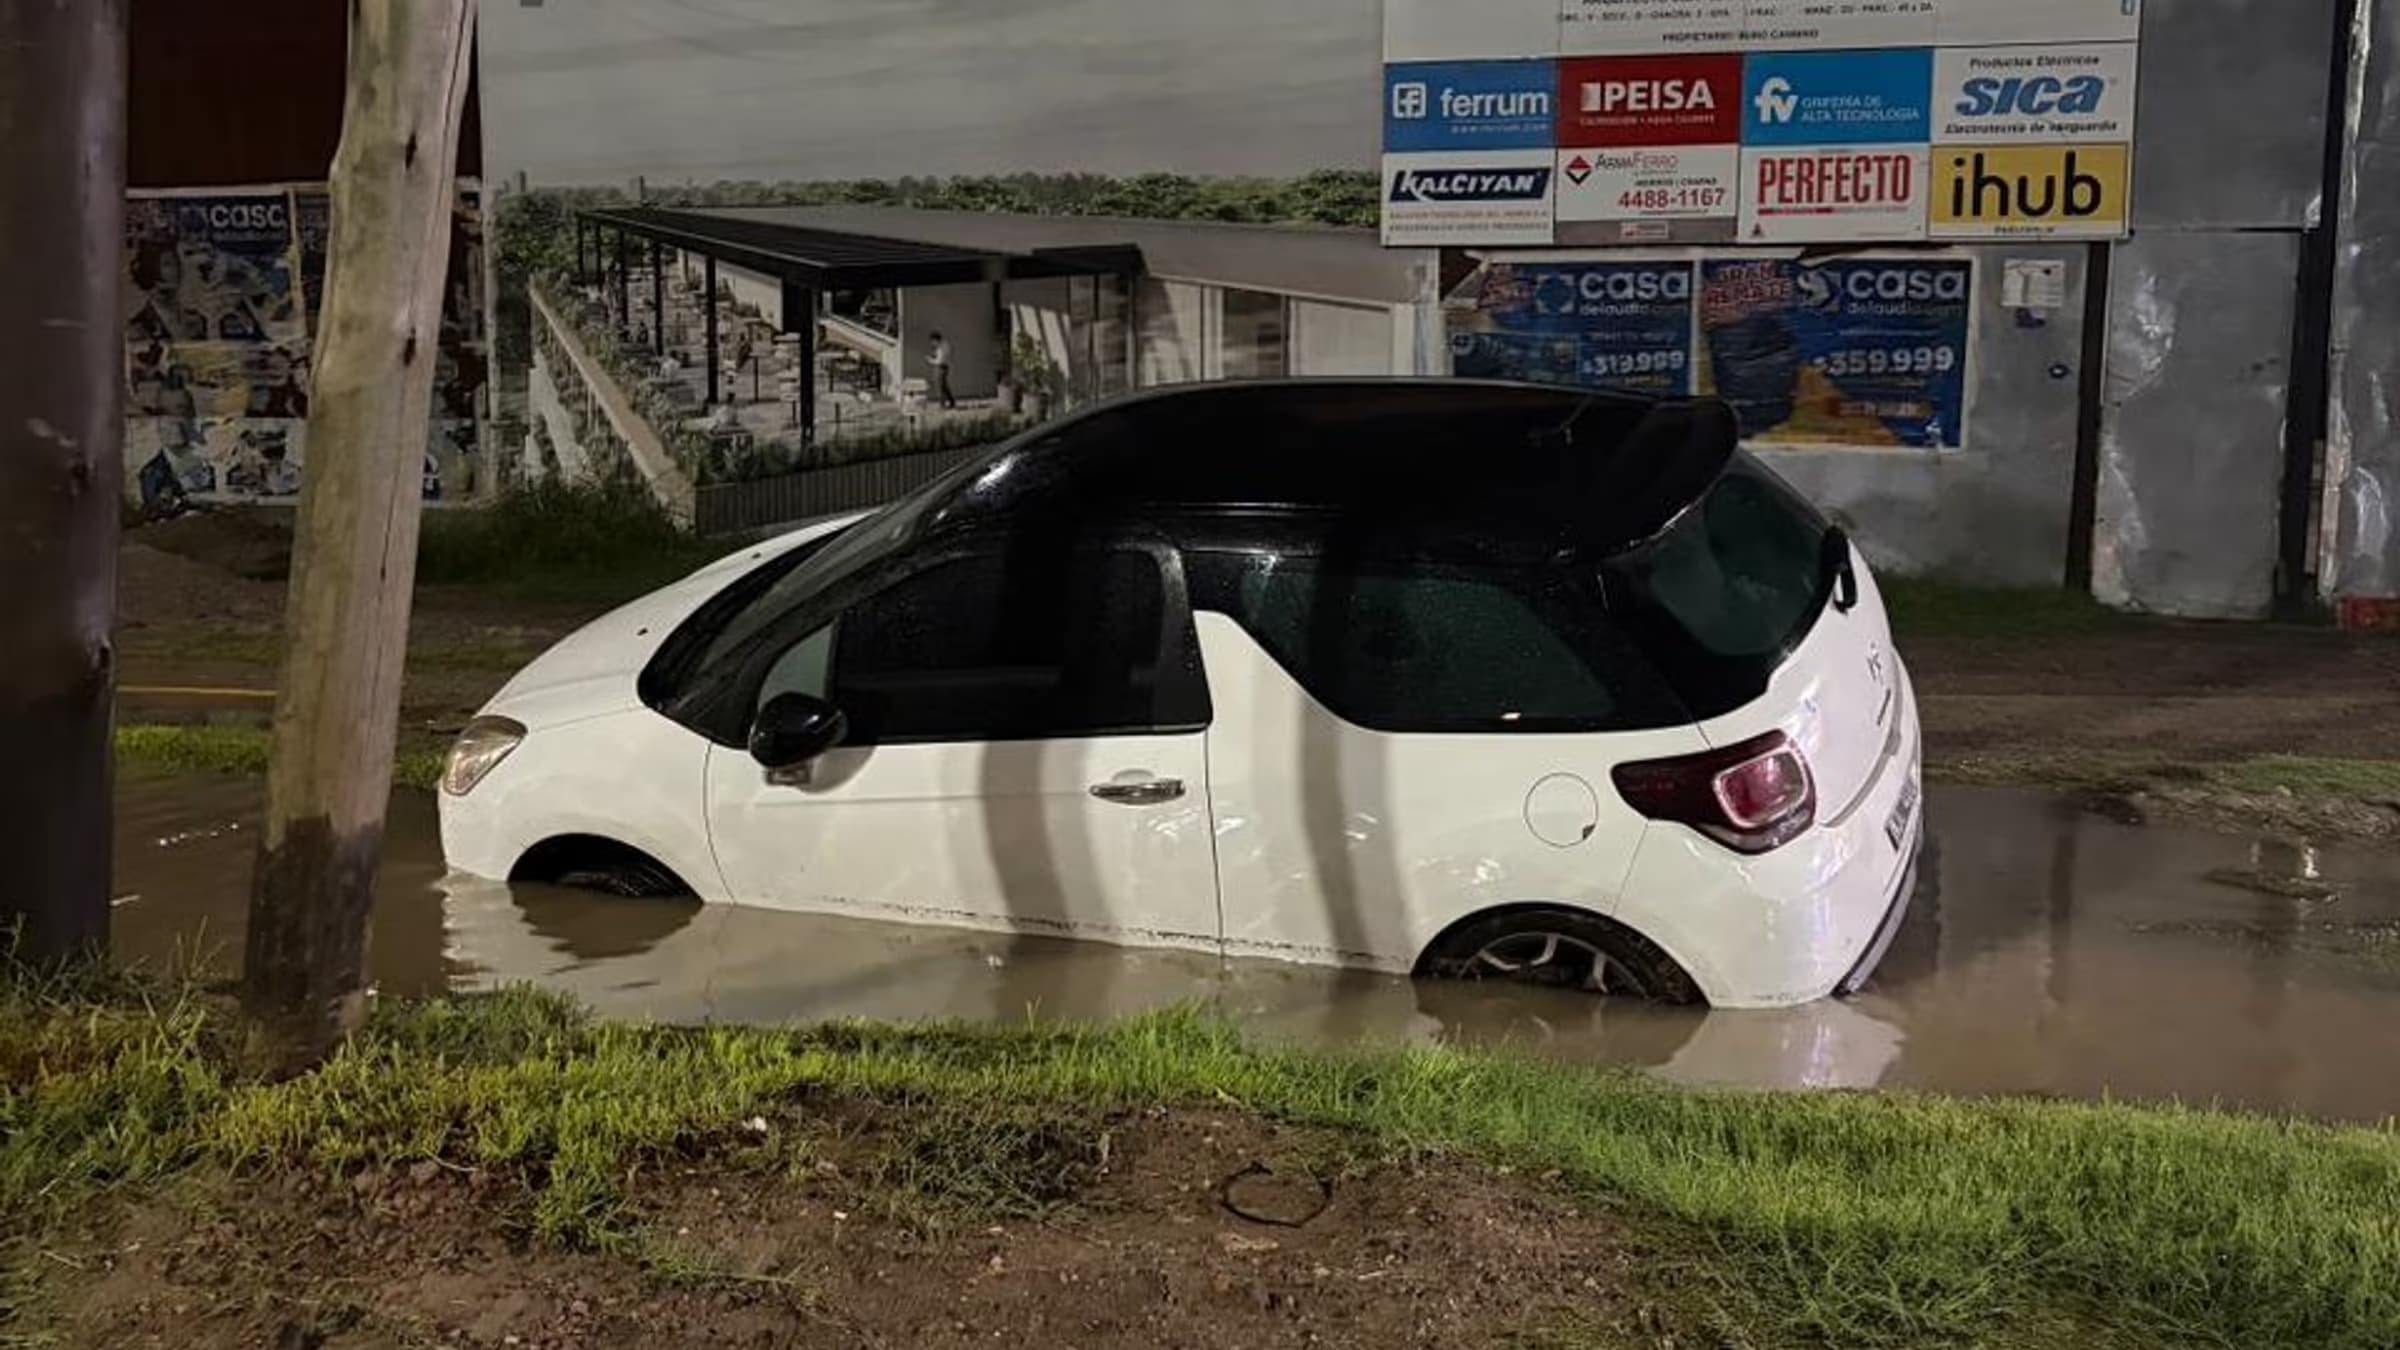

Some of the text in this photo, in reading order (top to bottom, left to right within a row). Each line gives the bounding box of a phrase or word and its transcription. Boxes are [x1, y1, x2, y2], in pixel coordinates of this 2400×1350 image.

[1440, 88, 1549, 118] ferrum
[1604, 80, 1715, 112] PEISA
[1758, 155, 1911, 205] PERFECTO
[1952, 151, 2102, 217] ihub
[1618, 187, 1726, 209] 4488-1167
[1579, 271, 1689, 299] casa
[1847, 270, 1965, 299] casa
